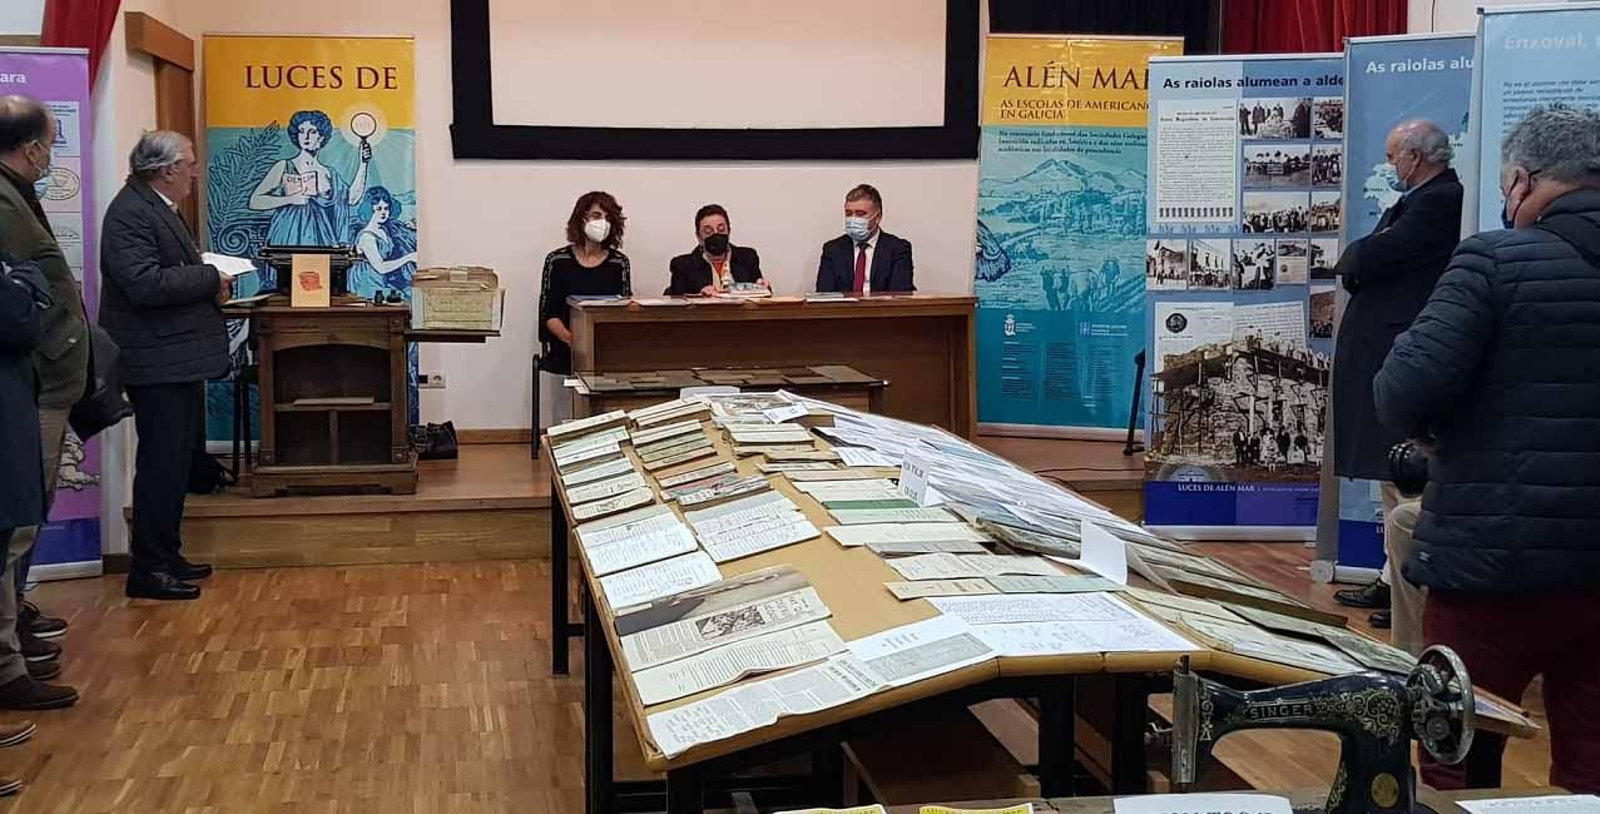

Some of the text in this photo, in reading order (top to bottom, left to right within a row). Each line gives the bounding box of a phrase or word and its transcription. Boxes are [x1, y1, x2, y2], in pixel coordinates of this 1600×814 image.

[1366, 61, 1386, 73] As
[1390, 57, 1444, 73] raiolas
[245, 65, 398, 90] LUCES DE
[1002, 60, 1080, 89] ALÉN
[1163, 78, 1180, 89] As
[1184, 76, 1232, 89] raiolas
[1236, 76, 1298, 87] alumean
[1302, 77, 1311, 86] a
[1000, 99, 1014, 109] AS
[1016, 99, 1064, 110] ESCOLAS
[1066, 100, 1081, 110] DE
[1000, 109, 1064, 120] EN GALICIA
[1178, 483, 1202, 492] LUCES
[1203, 483, 1214, 491] DE
[1237, 483, 1255, 492] MAR
[1249, 704, 1313, 718] SINGER
